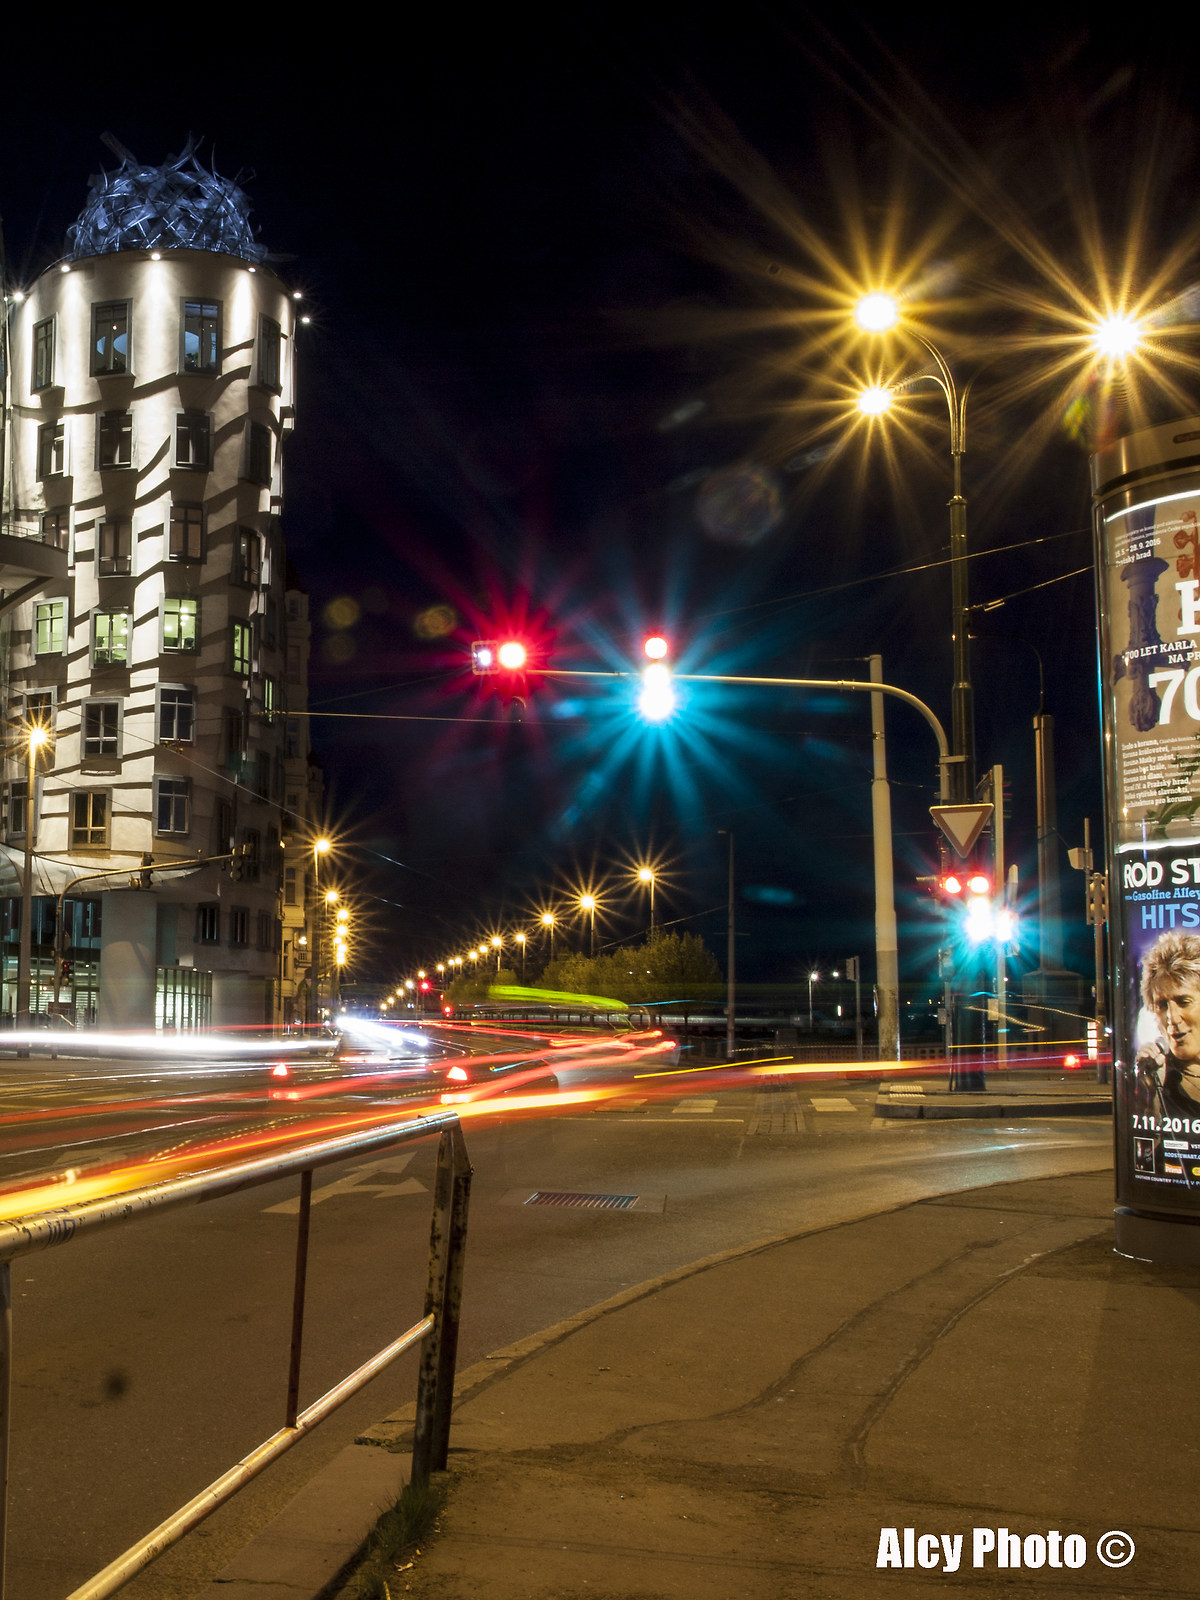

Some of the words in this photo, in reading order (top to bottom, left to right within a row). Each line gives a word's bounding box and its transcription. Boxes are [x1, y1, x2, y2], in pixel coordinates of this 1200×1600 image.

[1135, 549, 1152, 560] hrad
[1140, 645, 1158, 657] LET
[1160, 640, 1197, 653] KARLA
[1168, 653, 1185, 664] NA
[1123, 861, 1164, 889] ROD
[1170, 857, 1200, 885] ST
[1132, 889, 1171, 901] Gasoline
[1141, 903, 1200, 929] HITS
